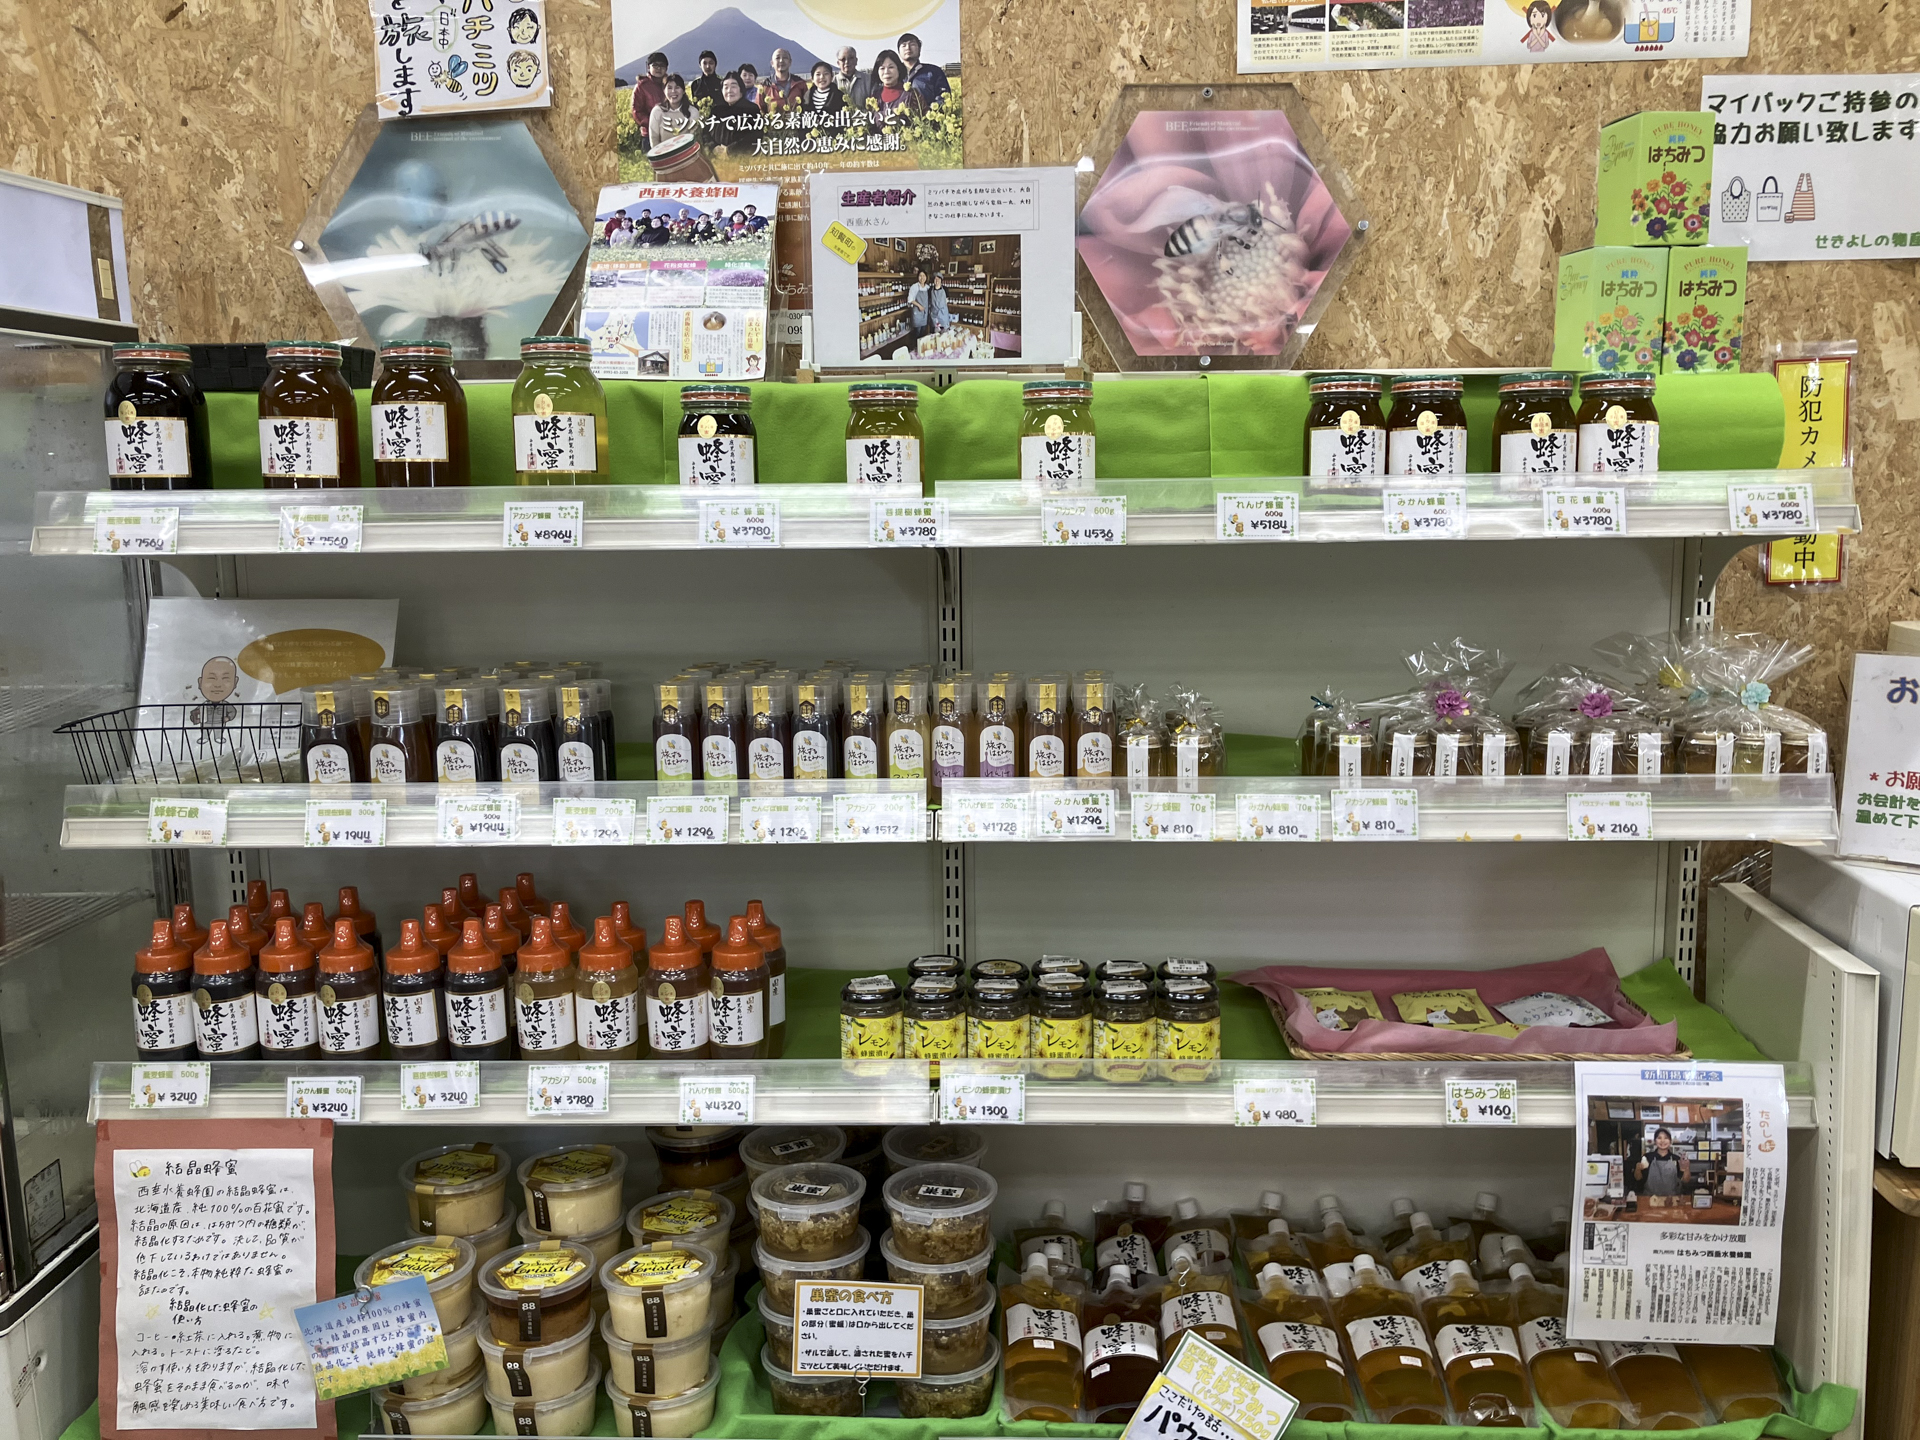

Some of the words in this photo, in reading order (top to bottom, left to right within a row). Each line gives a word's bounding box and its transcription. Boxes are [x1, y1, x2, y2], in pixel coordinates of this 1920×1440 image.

[1708, 90, 1919, 114] マイバックご持参の
[661, 109, 908, 133] ミツバチで広がる素敵な出会いと、
[1166, 122, 1188, 132] BEE
[411, 131, 433, 141] BEE
[1668, 135, 1685, 144] 純粋
[751, 133, 908, 157] 大自然の恵みに感謝。
[1647, 145, 1705, 163] はちみつ
[639, 186, 739, 199] 西垂水養蜂園
[840, 189, 916, 207] 生産者紹介
[1621, 270, 1638, 279] 純粋
[1700, 270, 1717, 278] 純粋
[1601, 280, 1658, 298] はちみつ
[1680, 280, 1737, 297] はちみつ
[122, 420, 153, 473] 蜂蜜
[274, 420, 304, 473] 蜂蜜
[535, 416, 566, 469] 蜂蜜
[1557, 496, 1605, 504] 百花蜂蜜
[1747, 492, 1797, 500] りんご蜂蜜
[1236, 500, 1284, 510] れんげ蜂蜜
[1398, 498, 1445, 506] みかん蜂蜜
[512, 512, 552, 520] アカシア蜂蜜
[1094, 507, 1115, 516] 600g
[1762, 510, 1802, 520] ¥3780
[1251, 520, 1288, 530] ¥5184
[1573, 516, 1612, 525] ¥3780
[534, 529, 572, 540] ¥8964
[732, 526, 771, 536] ¥3780
[899, 526, 937, 536] ¥3780
[1084, 529, 1114, 538] 4536
[136, 538, 164, 547] 7560
[320, 536, 348, 546] 7560
[1054, 797, 1100, 806] みかん蜂蜜
[1395, 798, 1408, 806] 70g
[700, 806, 717, 814] 200g
[846, 804, 876, 812] アカシア
[1144, 803, 1180, 812] シナ蜂蜜
[1190, 803, 1206, 812] 70g
[1298, 804, 1312, 813] 70g
[1067, 816, 1101, 825] ¥1296
[1375, 820, 1396, 830] 810
[470, 823, 504, 832] ¥1944
[687, 827, 713, 837] 1296
[983, 822, 1017, 832] ¥1728
[1173, 825, 1193, 833] 810
[1278, 825, 1298, 835] 810
[1610, 824, 1638, 833] 2160
[345, 831, 371, 841] 1944
[138, 1001, 166, 1049] 蜂蜜
[451, 997, 478, 1044] 蜂蜜
[595, 1000, 625, 1049] 蜂蜜
[200, 1004, 229, 1051] 蜂蜜
[455, 1070, 472, 1078] 500g
[540, 1076, 570, 1084] アカシア
[578, 1076, 596, 1085] 500g
[689, 1087, 721, 1095] れんげ蜂蜜
[954, 1086, 1012, 1095] レモンの蜂蜜漬け
[1452, 1087, 1511, 1100] はちみつ飴
[170, 1092, 197, 1101] 3240
[441, 1092, 468, 1101] 3240
[567, 1095, 594, 1105] 3780
[312, 1103, 348, 1113] ¥3240
[705, 1101, 741, 1111] ¥4320
[981, 1106, 1008, 1116] 1300
[1478, 1105, 1511, 1116] ¥160
[1275, 1110, 1297, 1120] 980
[165, 1160, 238, 1176] 結晶蜂蜜
[1660, 1231, 1746, 1244] 多彩な甘みをかけ放題
[1676, 1248, 1752, 1260] はちみつ西垂水養蜂園
[514, 1260, 572, 1274] Cristal
[630, 1260, 686, 1274] Cristal
[810, 1288, 894, 1304] 巣蜜の食べ方
[169, 1299, 258, 1313] 結晶化した蜂蜜の
[522, 1302, 535, 1311] 88
[172, 1314, 202, 1326] 使い方
[304, 1299, 421, 1337] 北海道産純粋100%の蜂蜜
[1373, 1316, 1404, 1347] 蜂蜜
[1101, 1324, 1129, 1355] 蜂蜜
[1177, 1353, 1281, 1426] 百花はちみつ
[518, 1417, 532, 1426] 88
